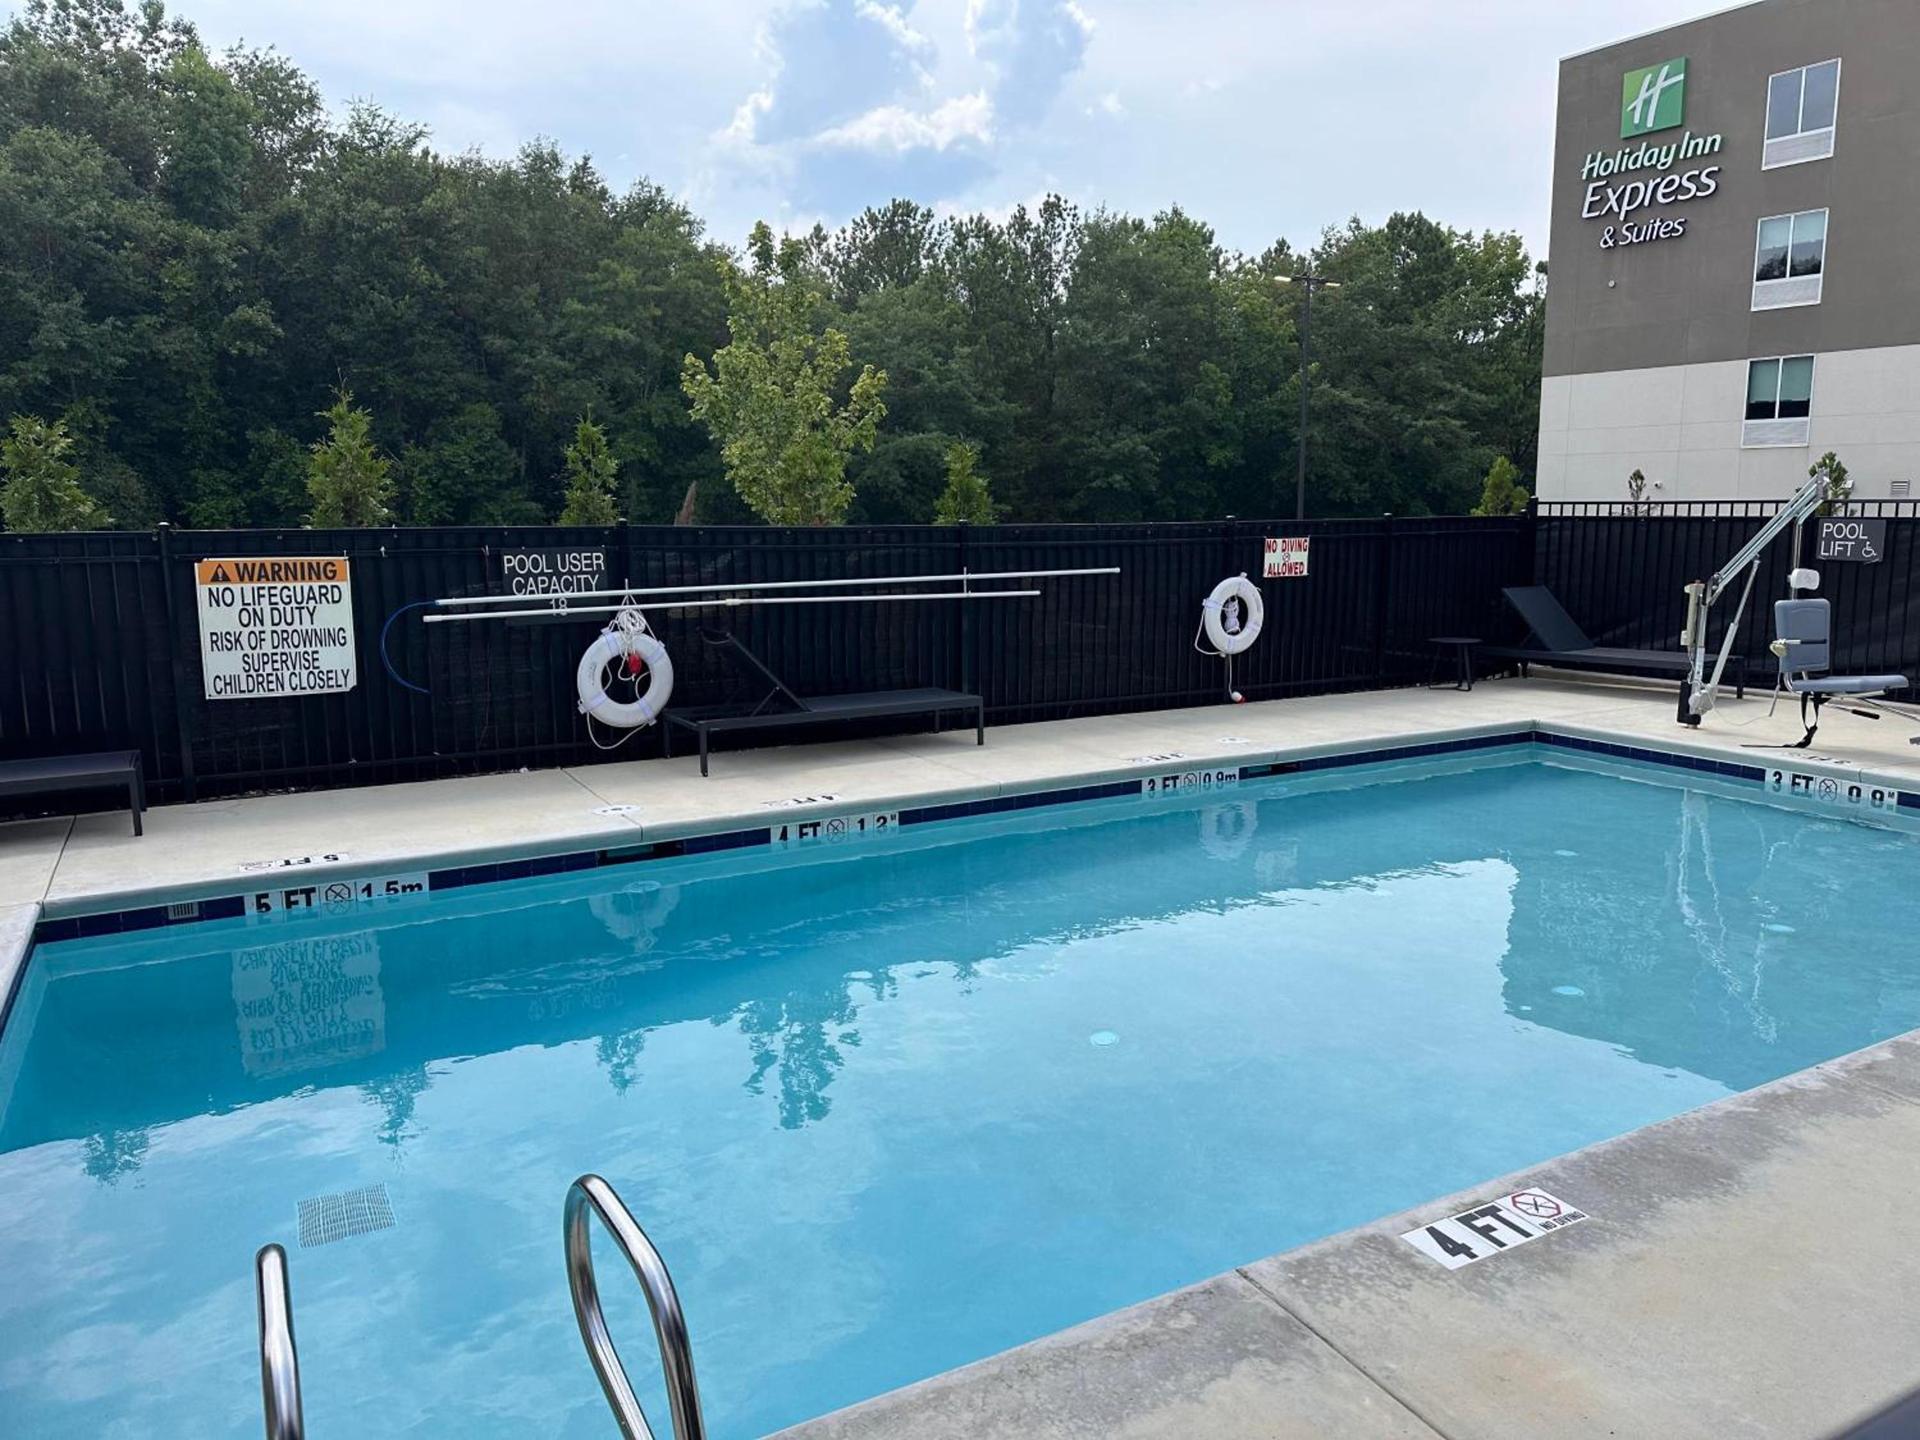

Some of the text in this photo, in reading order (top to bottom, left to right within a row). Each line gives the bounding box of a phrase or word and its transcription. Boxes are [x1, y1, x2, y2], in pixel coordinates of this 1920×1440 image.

[1581, 131, 1721, 180] Holiday Inn
[1582, 166, 1719, 221] Express
[1600, 217, 1686, 248] & Suites
[1822, 523, 1868, 539] POOL
[1265, 539, 1308, 553] NO DIVING
[1821, 541, 1855, 557] LIFT
[234, 562, 337, 582] WARNING
[503, 552, 605, 574] POOL USER
[1267, 562, 1304, 576] ALLOWED
[512, 574, 599, 596] CAPACITY
[208, 585, 342, 607] NO LIFEGUARD
[550, 597, 568, 616] 18
[238, 606, 317, 627] ON DUTY
[210, 627, 347, 652] RISK OF DROWNING
[242, 651, 320, 673] SUPERVISE
[213, 669, 350, 695] CHILDREN CLOSELY
[1162, 775, 1180, 790] FT
[1791, 773, 1814, 789] FT
[799, 821, 821, 839] FT
[255, 893, 272, 913] 5
[284, 887, 317, 910] FT
[1538, 1210, 1586, 1231] NO DIVING
[1425, 1204, 1534, 1260] 4 FT
